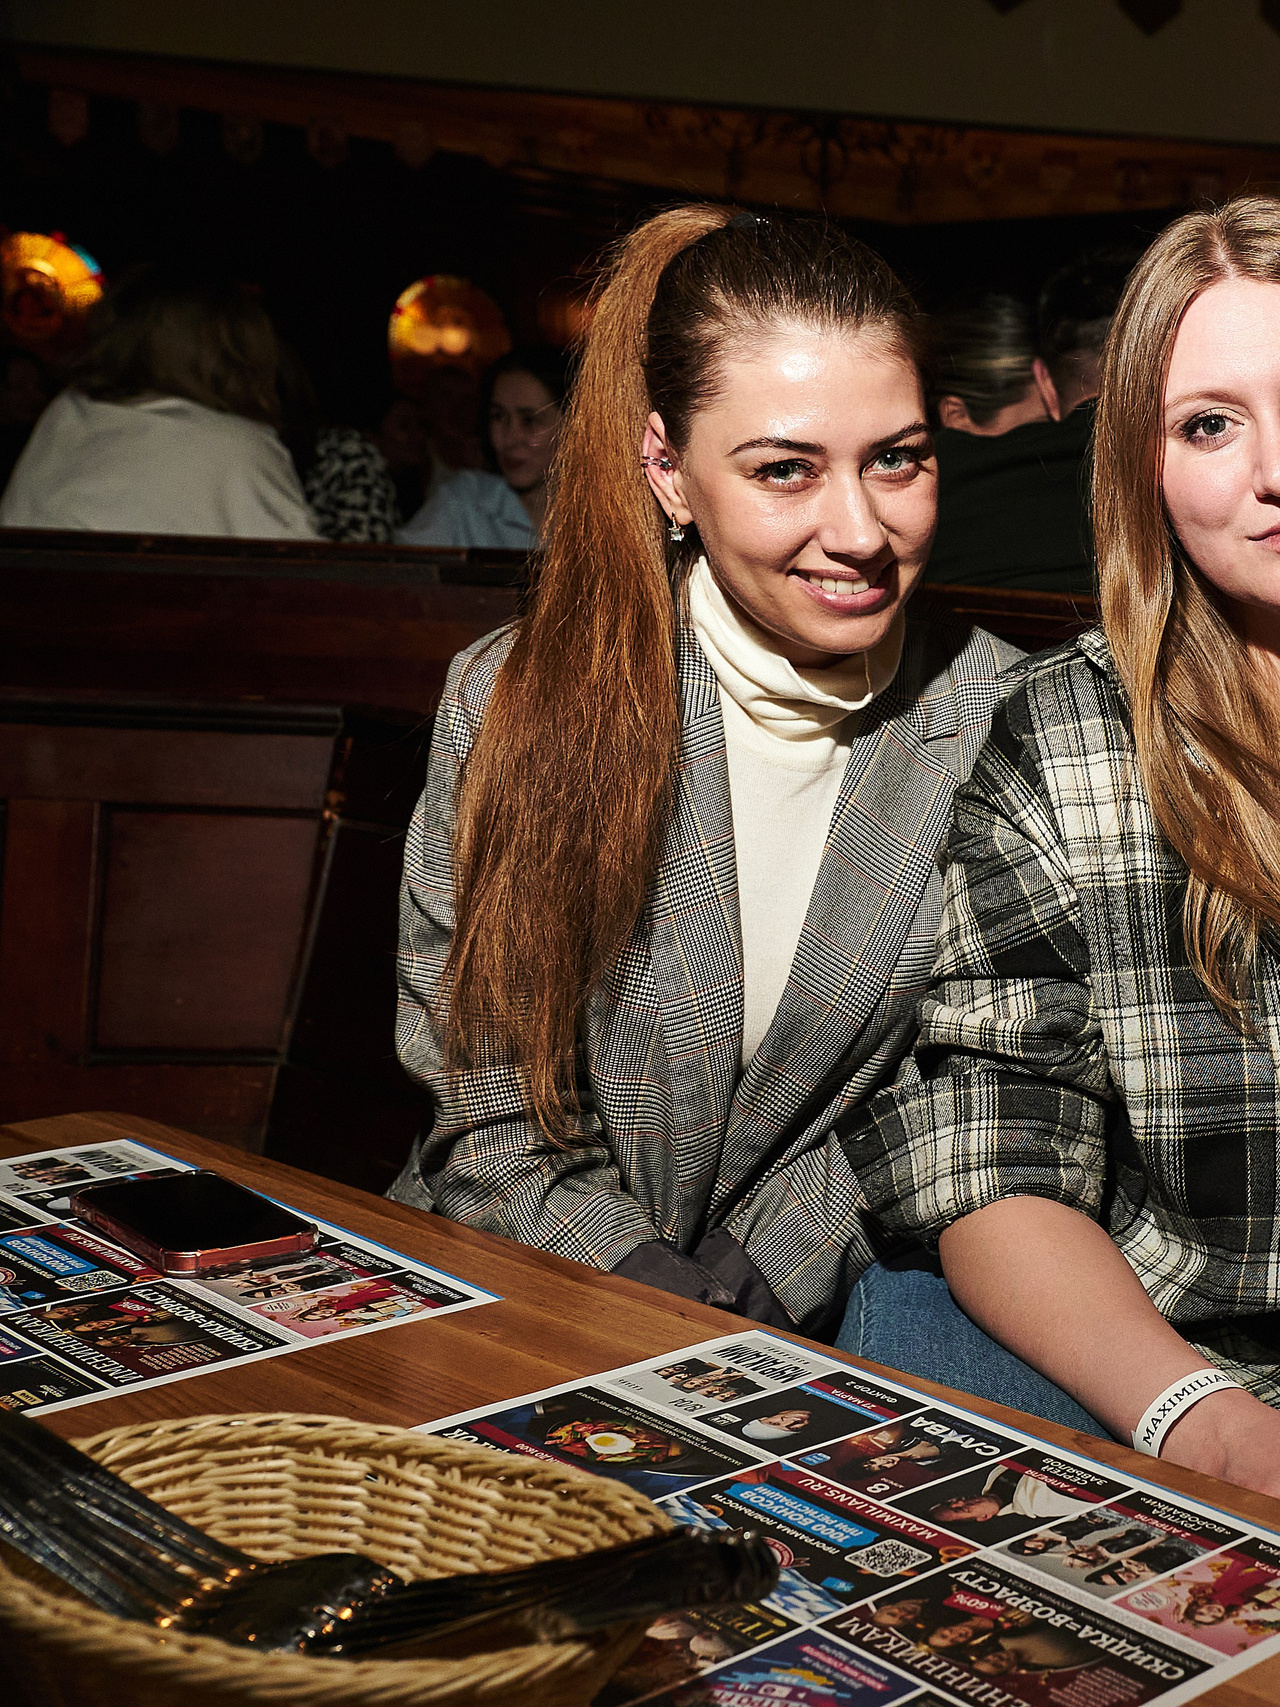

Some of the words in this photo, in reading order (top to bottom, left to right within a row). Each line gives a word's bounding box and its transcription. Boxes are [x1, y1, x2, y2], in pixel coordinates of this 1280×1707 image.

[130, 1289, 262, 1350] СКИДКА=ВОЗРАСТУ
[9, 1314, 142, 1382] ИМЕНИННИКАМ
[831, 1389, 864, 1404] МАРТА
[854, 1384, 897, 1403] ФАКТОР
[860, 1401, 877, 1410] 27
[1025, 1469, 1070, 1488] АПРЕЛЯ
[1041, 1465, 1092, 1485] СЕРГЕЙ
[1042, 1458, 1107, 1485] ЗАВЬЯЛОВ
[865, 1482, 891, 1494] 8
[711, 1494, 777, 1525] ЛОЯЛЬНОСТИ
[740, 1491, 814, 1526] БОНУСОВ
[754, 1486, 837, 1524] РЕГИСТРАЦИИ
[798, 1479, 937, 1538] MAXIMILIANS.RU
[1140, 1498, 1230, 1534] «ВОРОВАЙКИ»
[833, 1522, 864, 1536] ПРИ
[1134, 1514, 1182, 1533] АПРЕЛЯ
[1152, 1508, 1206, 1531] ГРУППА
[776, 1524, 840, 1554] ПРОГРАММА
[811, 1524, 850, 1542] 1000
[954, 1594, 992, 1609] 60%
[950, 1571, 1183, 1678] СКИДКА=ВОЗРАСТУ
